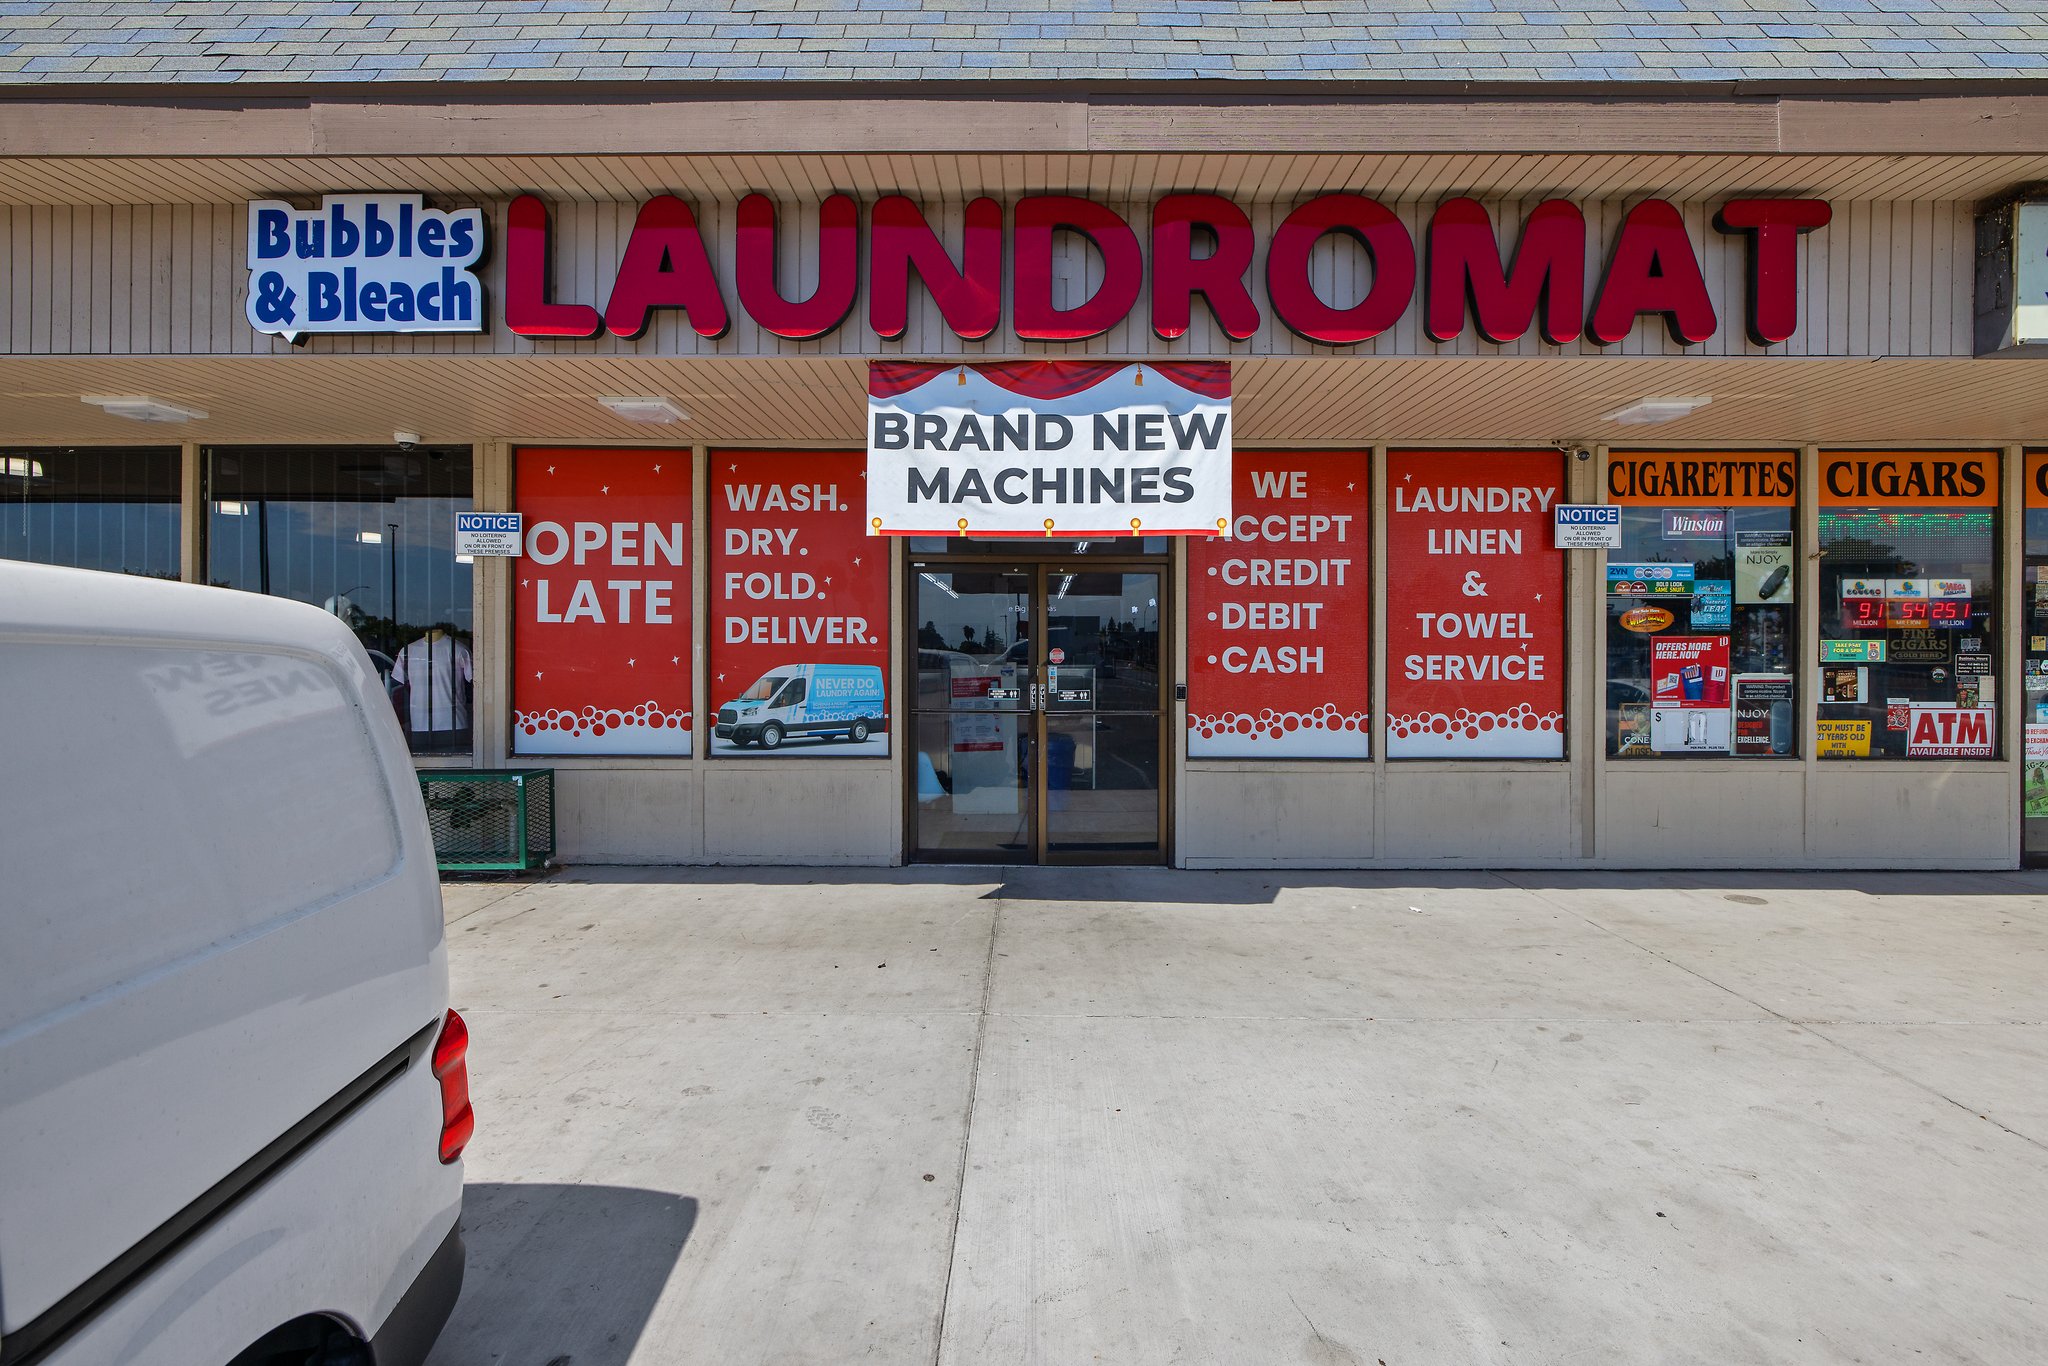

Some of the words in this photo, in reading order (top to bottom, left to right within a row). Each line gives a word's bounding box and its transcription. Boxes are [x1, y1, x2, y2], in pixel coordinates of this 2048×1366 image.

[257, 203, 474, 259] Bubbles
[505, 193, 1832, 345] LAUNDROMAT
[255, 271, 297, 326] &
[307, 266, 472, 322] Bleach
[874, 412, 1074, 451] BRAND
[1093, 413, 1227, 451] NEW
[907, 466, 1195, 504] MACHINES
[1250, 472, 1308, 498] WE
[1608, 461, 1795, 497] CIGARETTES
[1826, 461, 1986, 497] CIGARS
[724, 484, 848, 512] WASH.
[1395, 487, 1556, 513] LAUNDRY
[460, 516, 518, 529] NOTICE
[1560, 509, 1617, 522] NOTICE
[1673, 516, 1724, 532] Winston
[525, 521, 683, 566] OPEN
[725, 528, 808, 556] DRY.
[1429, 529, 1523, 555] LINEN
[1221, 558, 1352, 586] CREDIT
[1610, 567, 1628, 575] ZYN
[1746, 555, 1782, 565] NJOY
[725, 571, 826, 600] FOLD.
[1462, 570, 1489, 598] &
[536, 579, 673, 624] LATE
[1860, 602, 1884, 618] 91
[1902, 602, 1927, 618] 54
[1932, 602, 1970, 618] 251
[1222, 602, 1324, 630] DEBIT
[1416, 612, 1534, 639] TOWEL
[725, 617, 879, 644] DELIVER.
[1902, 629, 1936, 639] FINE
[1655, 642, 1688, 651] OFFERS
[1688, 642, 1713, 651] MORE
[1655, 651, 1701, 660] HERE.NOW
[1890, 639, 1948, 651] CIGARS
[1221, 646, 1325, 674] CASH
[1404, 655, 1545, 682] SERVICE
[816, 678, 854, 689] NEVER
[857, 678, 874, 689] DO
[816, 689, 852, 697] LAUNDRY
[853, 689, 880, 697] AGAIN!
[1655, 711, 1662, 723] $
[1737, 709, 1769, 718] NJOY
[1624, 736, 1650, 744] CONE
[1737, 736, 1771, 744] EXCELLENCE.
[1912, 713, 1988, 744] ATM
[1909, 747, 1959, 756] AVAILABLE
[1960, 748, 1991, 756] INSIDE
